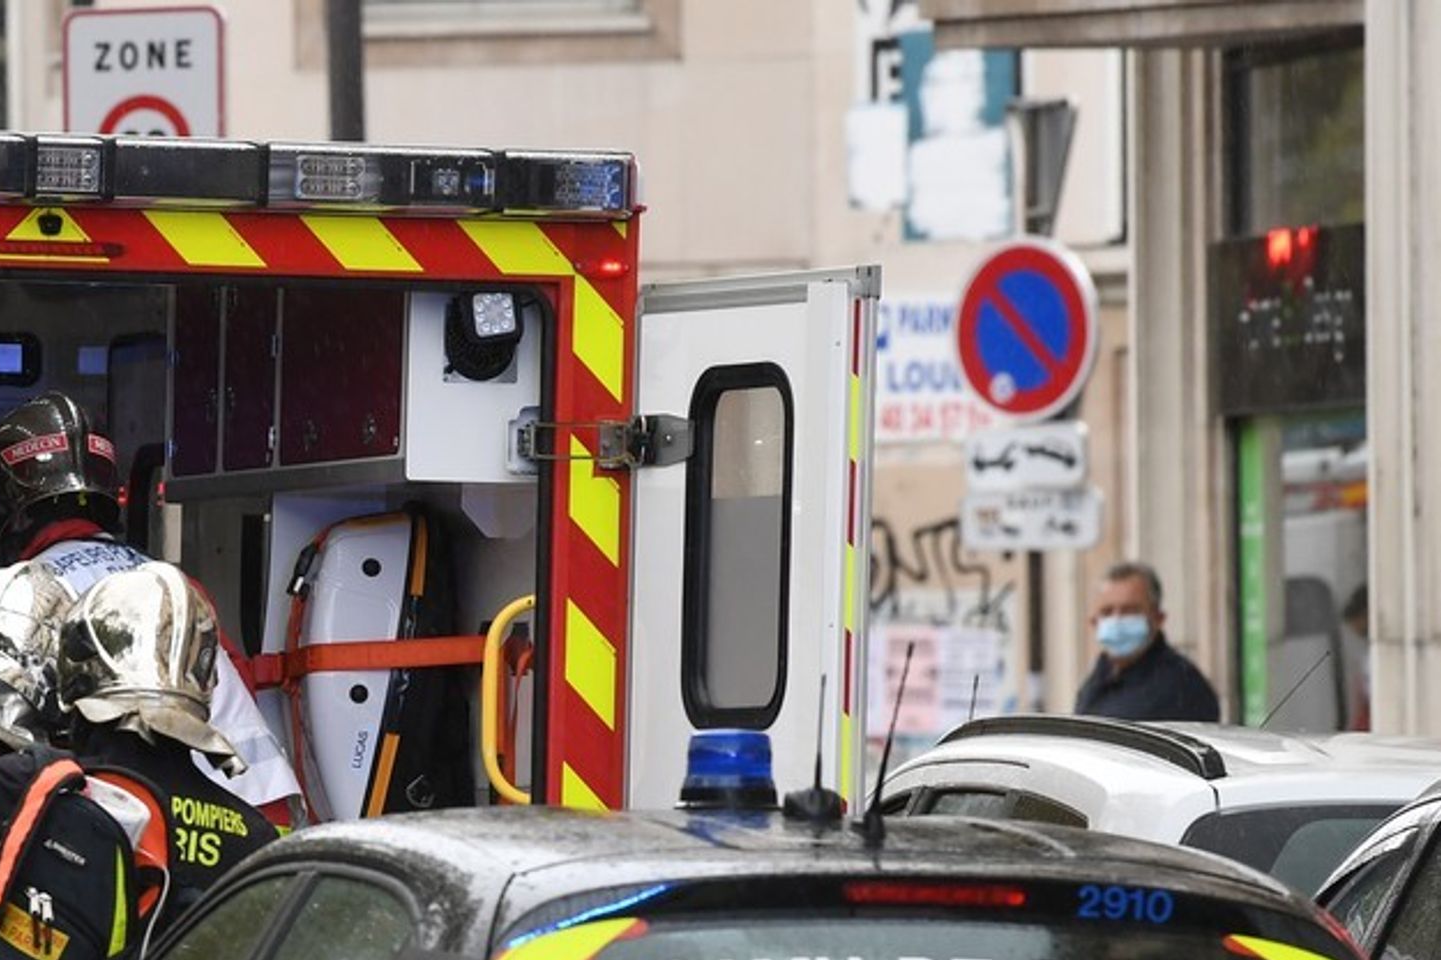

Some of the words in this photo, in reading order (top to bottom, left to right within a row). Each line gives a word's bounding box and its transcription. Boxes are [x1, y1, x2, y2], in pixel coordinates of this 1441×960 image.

[94, 39, 192, 72] ZONE
[171, 795, 248, 837] POMPIERS
[1078, 885, 1173, 923] 2910
